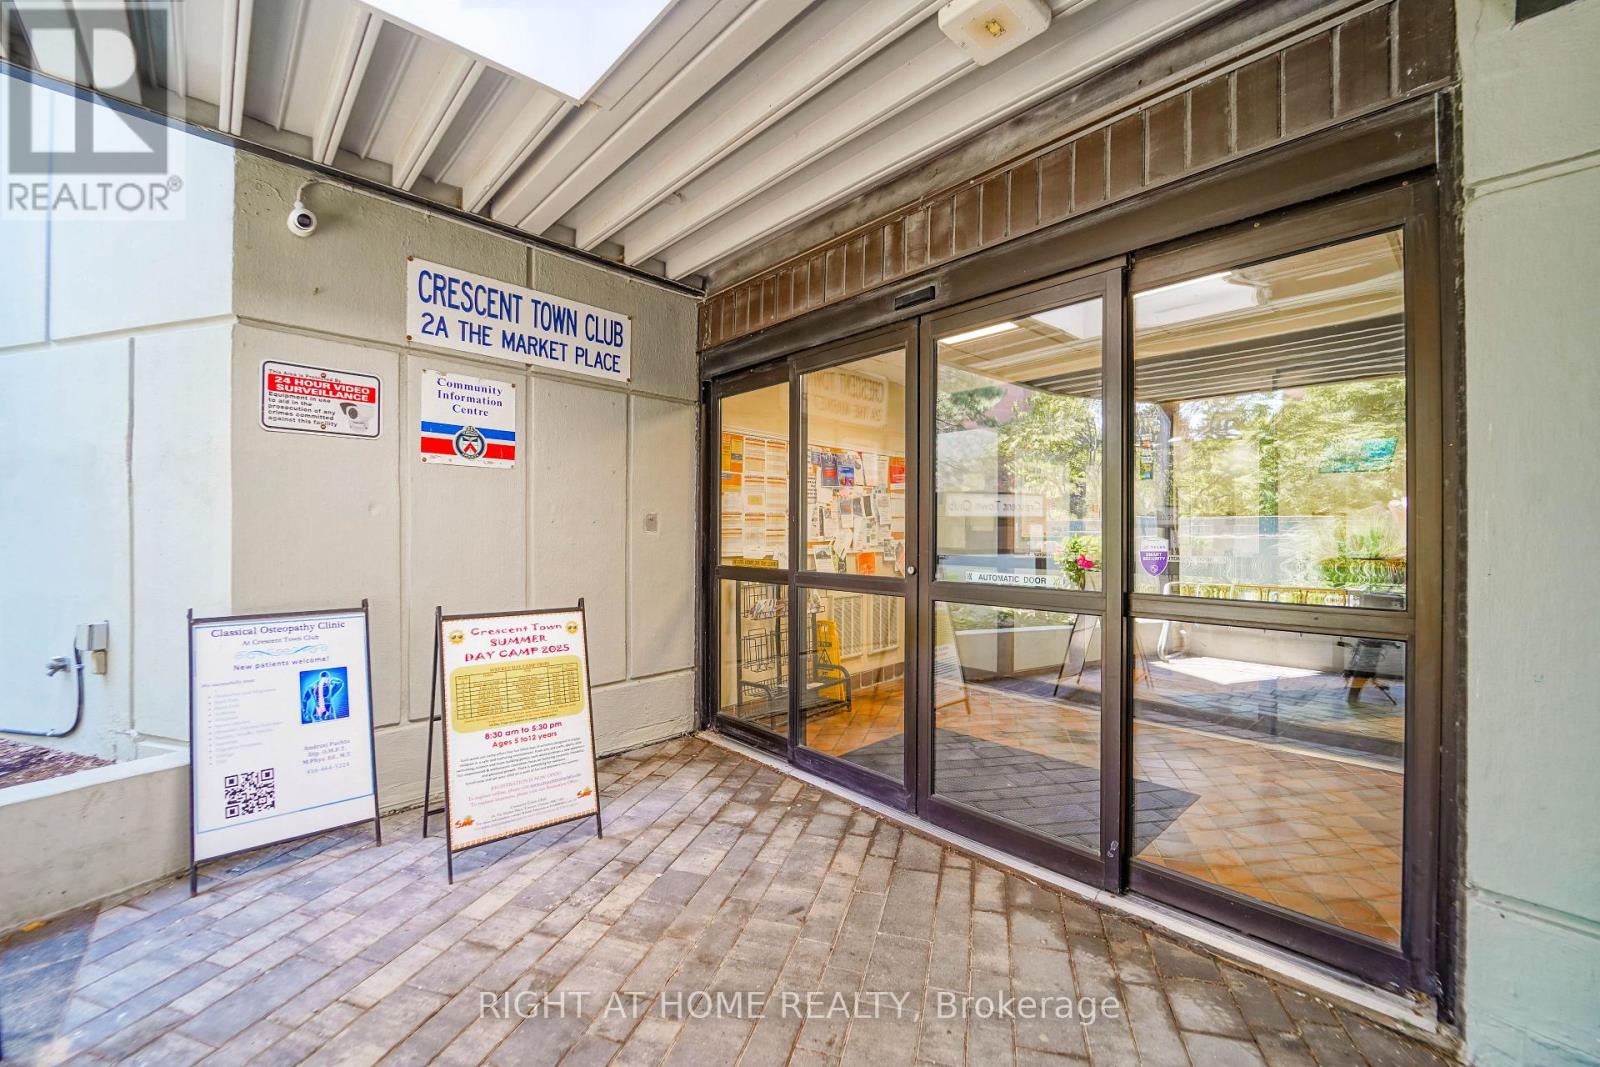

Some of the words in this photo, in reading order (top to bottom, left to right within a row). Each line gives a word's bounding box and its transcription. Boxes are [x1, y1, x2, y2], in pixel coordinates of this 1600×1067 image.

[418, 269, 523, 324] CRESCENT
[531, 298, 577, 337] TOWN
[585, 313, 624, 348] CLUB
[421, 312, 449, 338] 2A
[458, 319, 493, 347] THE
[502, 330, 568, 362] MARKET
[575, 347, 621, 373] PLACE
[274, 375, 291, 384] 24
[294, 378, 331, 390] HOUR
[333, 384, 370, 395] VIDEO
[276, 384, 369, 402] SURVEILLANCE
[436, 377, 503, 397] Community
[268, 391, 308, 400] Equipment
[437, 389, 503, 407] Information
[268, 404, 312, 412] prosecution
[268, 409, 293, 417] crimes
[295, 412, 334, 421] committed
[452, 403, 489, 417] Centre
[313, 420, 337, 428] facility
[978, 573, 1020, 583] AUTOMATIC
[1023, 576, 1047, 585] DOOR
[210, 626, 257, 638] Classical
[260, 623, 316, 635] Osteopathy
[317, 620, 346, 630] Clinic
[470, 626, 528, 636] Crescent
[531, 622, 562, 631] Town
[489, 634, 548, 647] SUMMER
[464, 650, 495, 662] DAY
[499, 646, 539, 658] CAMP
[541, 643, 570, 654] 2025
[255, 660, 289, 670] patients
[291, 656, 330, 665] welcome!
[484, 730, 503, 740] 8:30
[505, 728, 519, 736] am
[521, 725, 530, 734] to
[531, 722, 548, 732] 5:30
[549, 721, 562, 730] pm
[491, 738, 513, 749] Ages
[514, 736, 519, 744] 5
[537, 731, 557, 742] years
